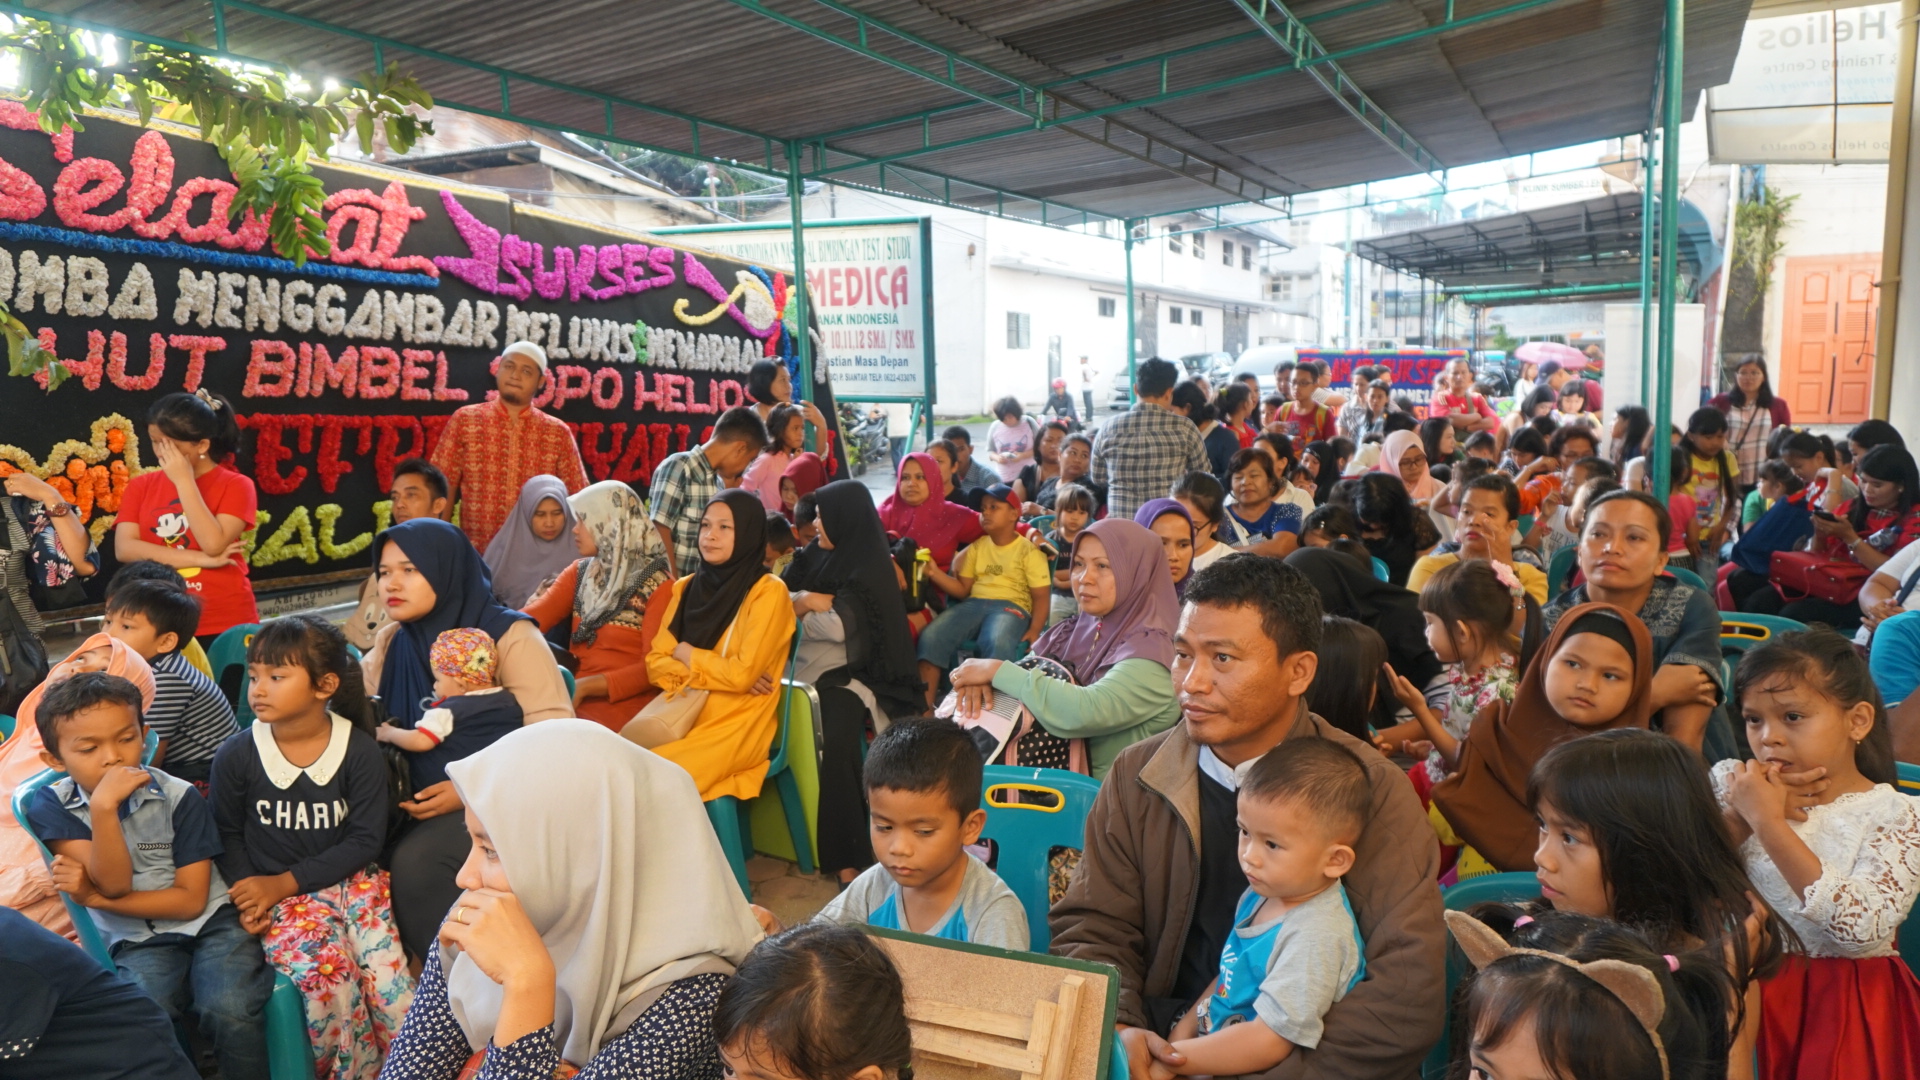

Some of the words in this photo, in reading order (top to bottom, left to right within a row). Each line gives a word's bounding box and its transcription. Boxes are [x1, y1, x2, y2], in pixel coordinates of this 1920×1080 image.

[496, 233, 676, 301] SUKSES
[818, 238, 861, 263] BIMBINGAN
[862, 236, 881, 261] TEST
[887, 235, 912, 260] STUDY
[805, 265, 909, 310] MEDICA
[172, 267, 499, 350] MENGGAMBAR
[846, 312, 899, 325] INDONESIA
[867, 330, 886, 350] SMA
[895, 329, 915, 348] SMK
[32, 327, 227, 394] HUT
[241, 338, 469, 401] BIMBEL
[855, 355, 878, 367] Masa
[880, 355, 909, 369] Depan
